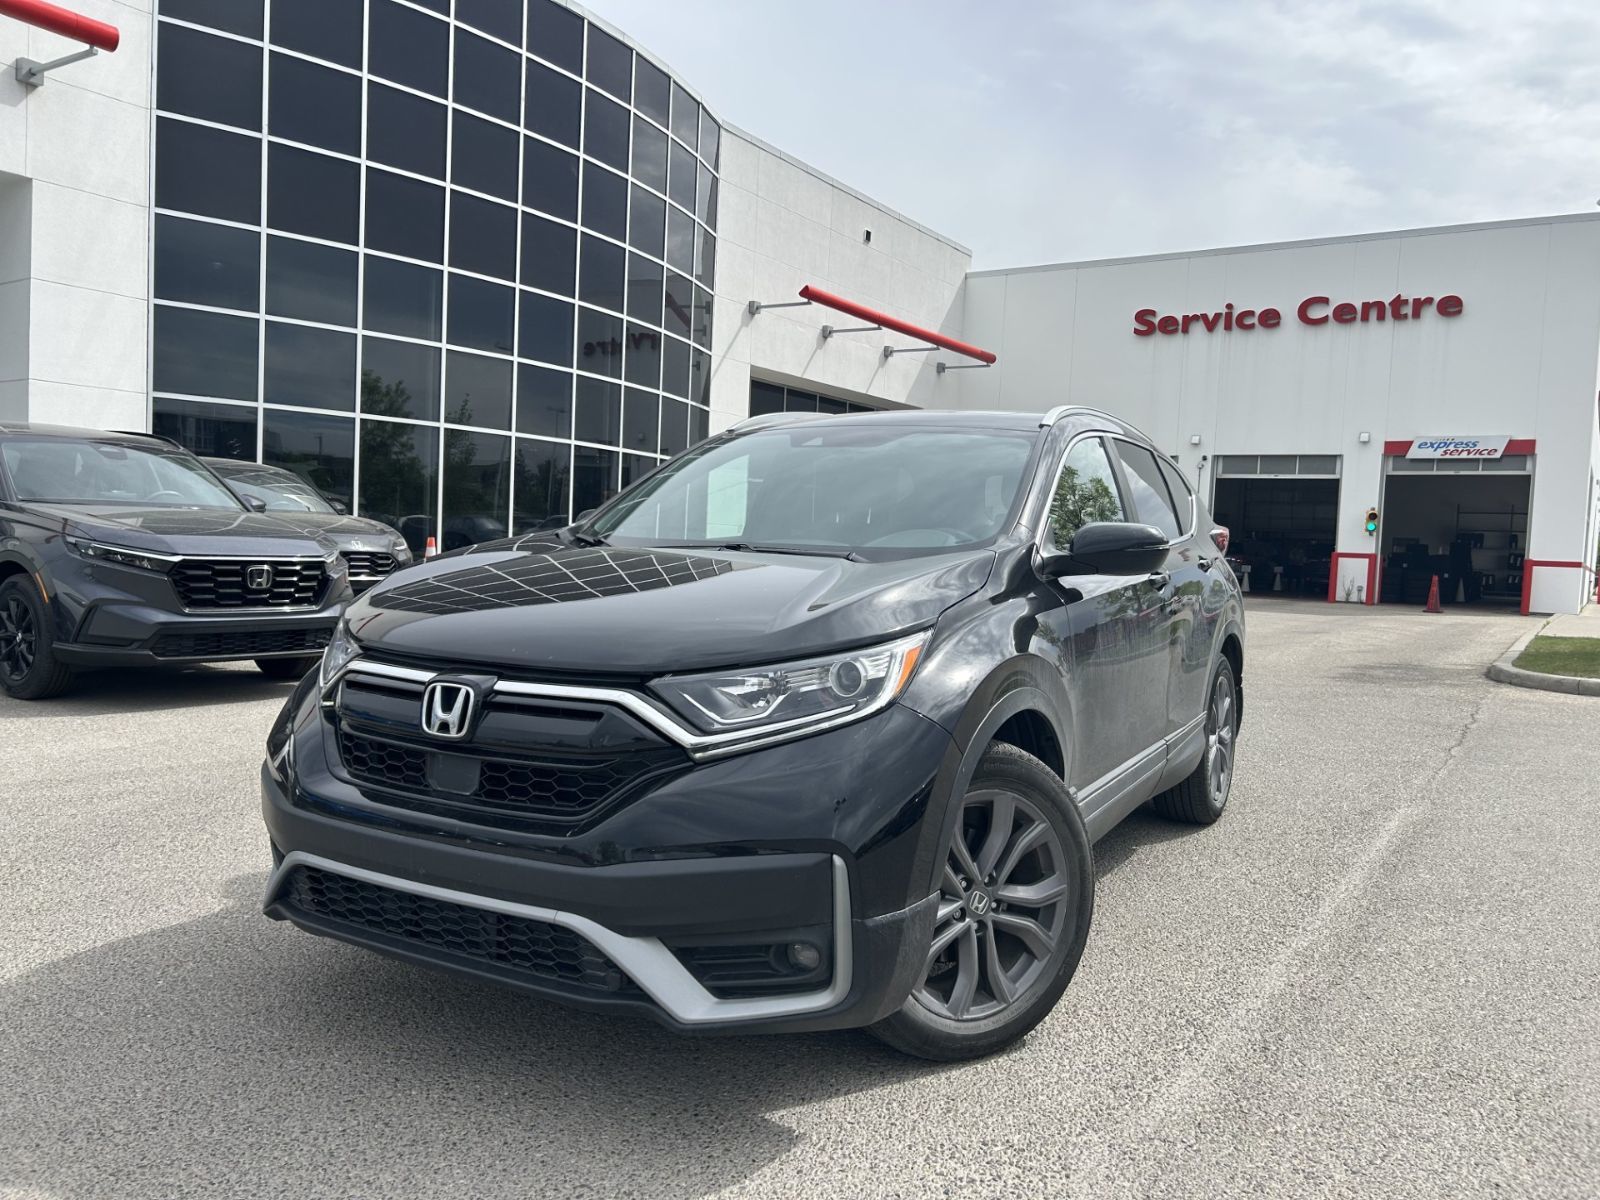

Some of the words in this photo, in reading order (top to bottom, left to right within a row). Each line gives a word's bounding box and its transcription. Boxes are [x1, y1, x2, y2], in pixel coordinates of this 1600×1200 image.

[1133, 302, 1282, 337] Service
[1297, 293, 1464, 326] Centre
[1417, 440, 1480, 453] express
[1440, 447, 1498, 457] service
